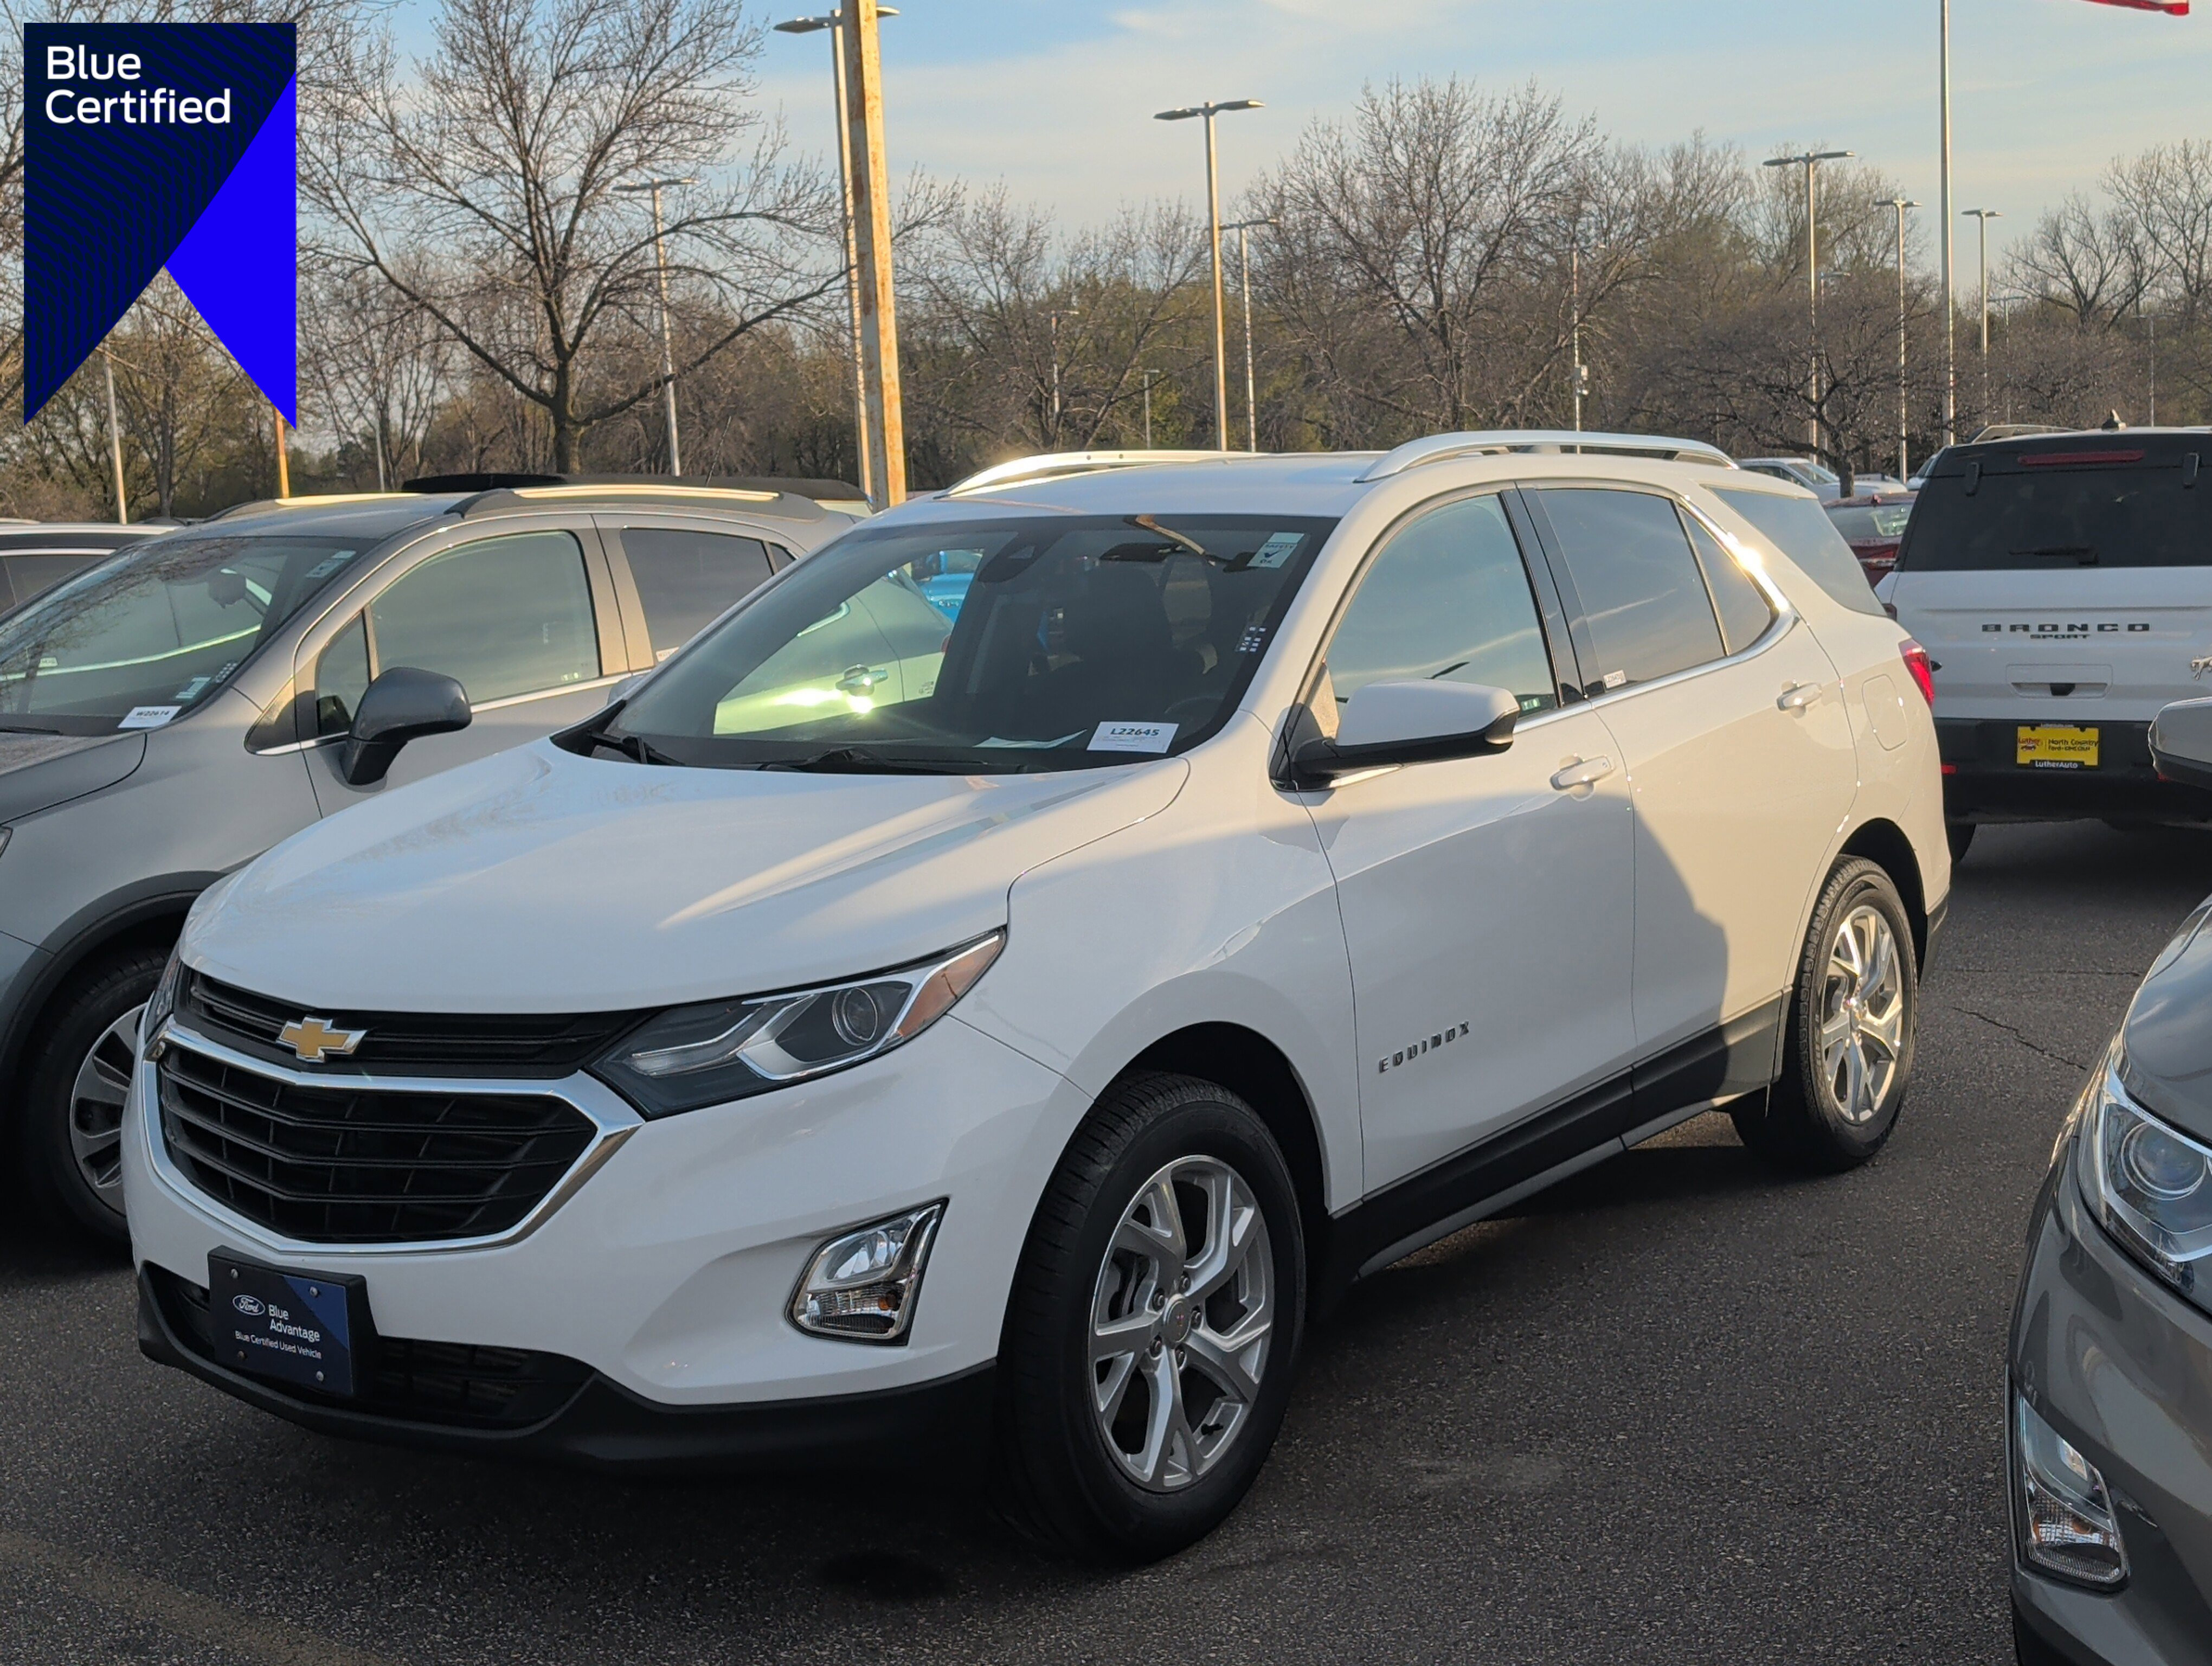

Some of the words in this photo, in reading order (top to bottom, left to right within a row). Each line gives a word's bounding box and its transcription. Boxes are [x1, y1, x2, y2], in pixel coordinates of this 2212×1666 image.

[1982, 624, 2150, 632] BRONCO
[1110, 728, 1160, 736] L22645
[2035, 760, 2078, 768] LutherAuto
[1379, 1020, 1469, 1073] EQUINOX
[239, 1297, 259, 1312] Ford
[268, 1304, 289, 1320] Blue
[270, 1319, 320, 1343] Advantage
[235, 1330, 250, 1342] Blue
[250, 1335, 279, 1349] Certified
[279, 1341, 297, 1354] Used
[297, 1345, 322, 1360] Vehicle
